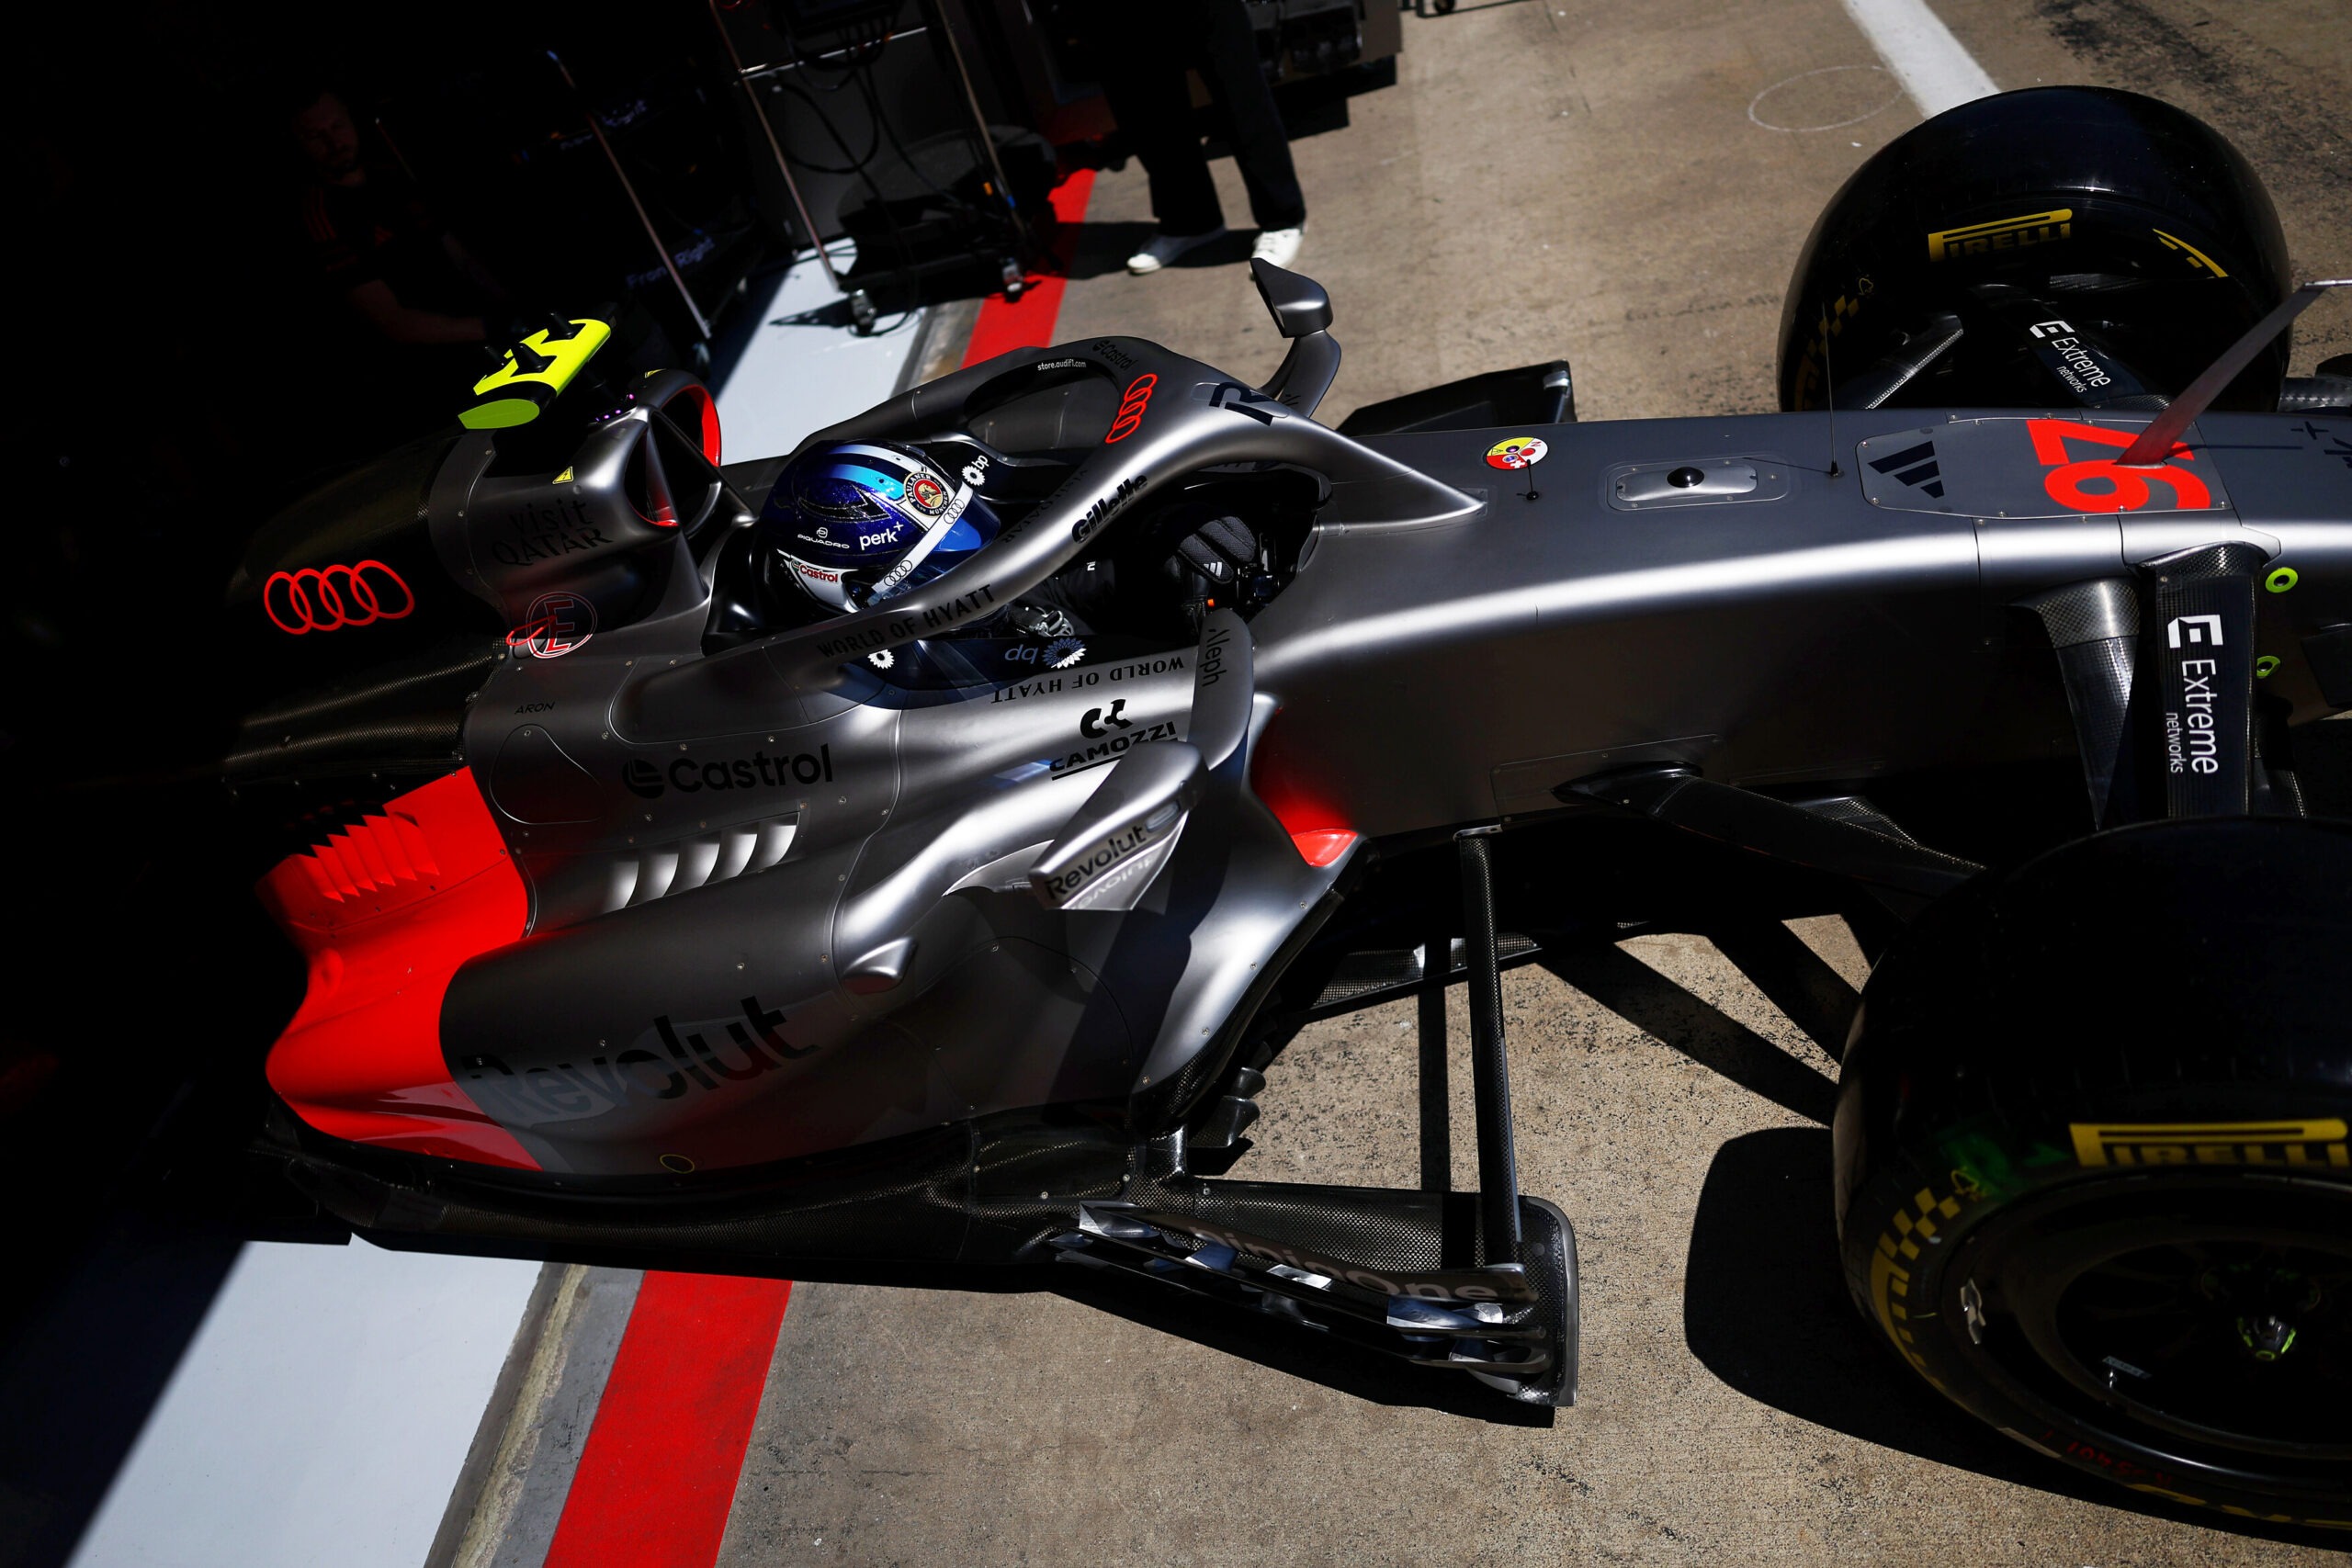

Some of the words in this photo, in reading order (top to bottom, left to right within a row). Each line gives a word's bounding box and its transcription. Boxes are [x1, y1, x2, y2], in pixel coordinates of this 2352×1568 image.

[1928, 208, 2073, 263] PIRELLI
[625, 263, 669, 291] Fron
[1036, 358, 1087, 371] store.audif1.com
[2052, 337, 2111, 387] Extreme
[2056, 366, 2087, 392] networks
[971, 455, 989, 470] bp
[2026, 419, 2211, 513] 97
[906, 472, 932, 503] PAULANER
[1071, 475, 1148, 543] Gillette
[492, 528, 613, 566] QATAR
[797, 534, 850, 549] PIQUADRO
[799, 565, 838, 582] Castrol
[817, 629, 885, 658] WORLD
[889, 616, 919, 639] OF
[922, 584, 995, 628] HYATT
[1005, 644, 1038, 664] bp
[1110, 657, 1184, 682] WORLD
[991, 679, 1062, 704] HYATT
[1071, 672, 1100, 689] OF
[514, 701, 555, 715] ARON
[2181, 659, 2219, 775] Extreme
[1049, 721, 1176, 772] CAMOZZI
[2165, 712, 2187, 773] networks
[668, 743, 833, 793] Castrol
[1044, 825, 1146, 900] Revolut
[461, 996, 822, 1119] Revolut
[2069, 1118, 2350, 1168] PIRELLI
